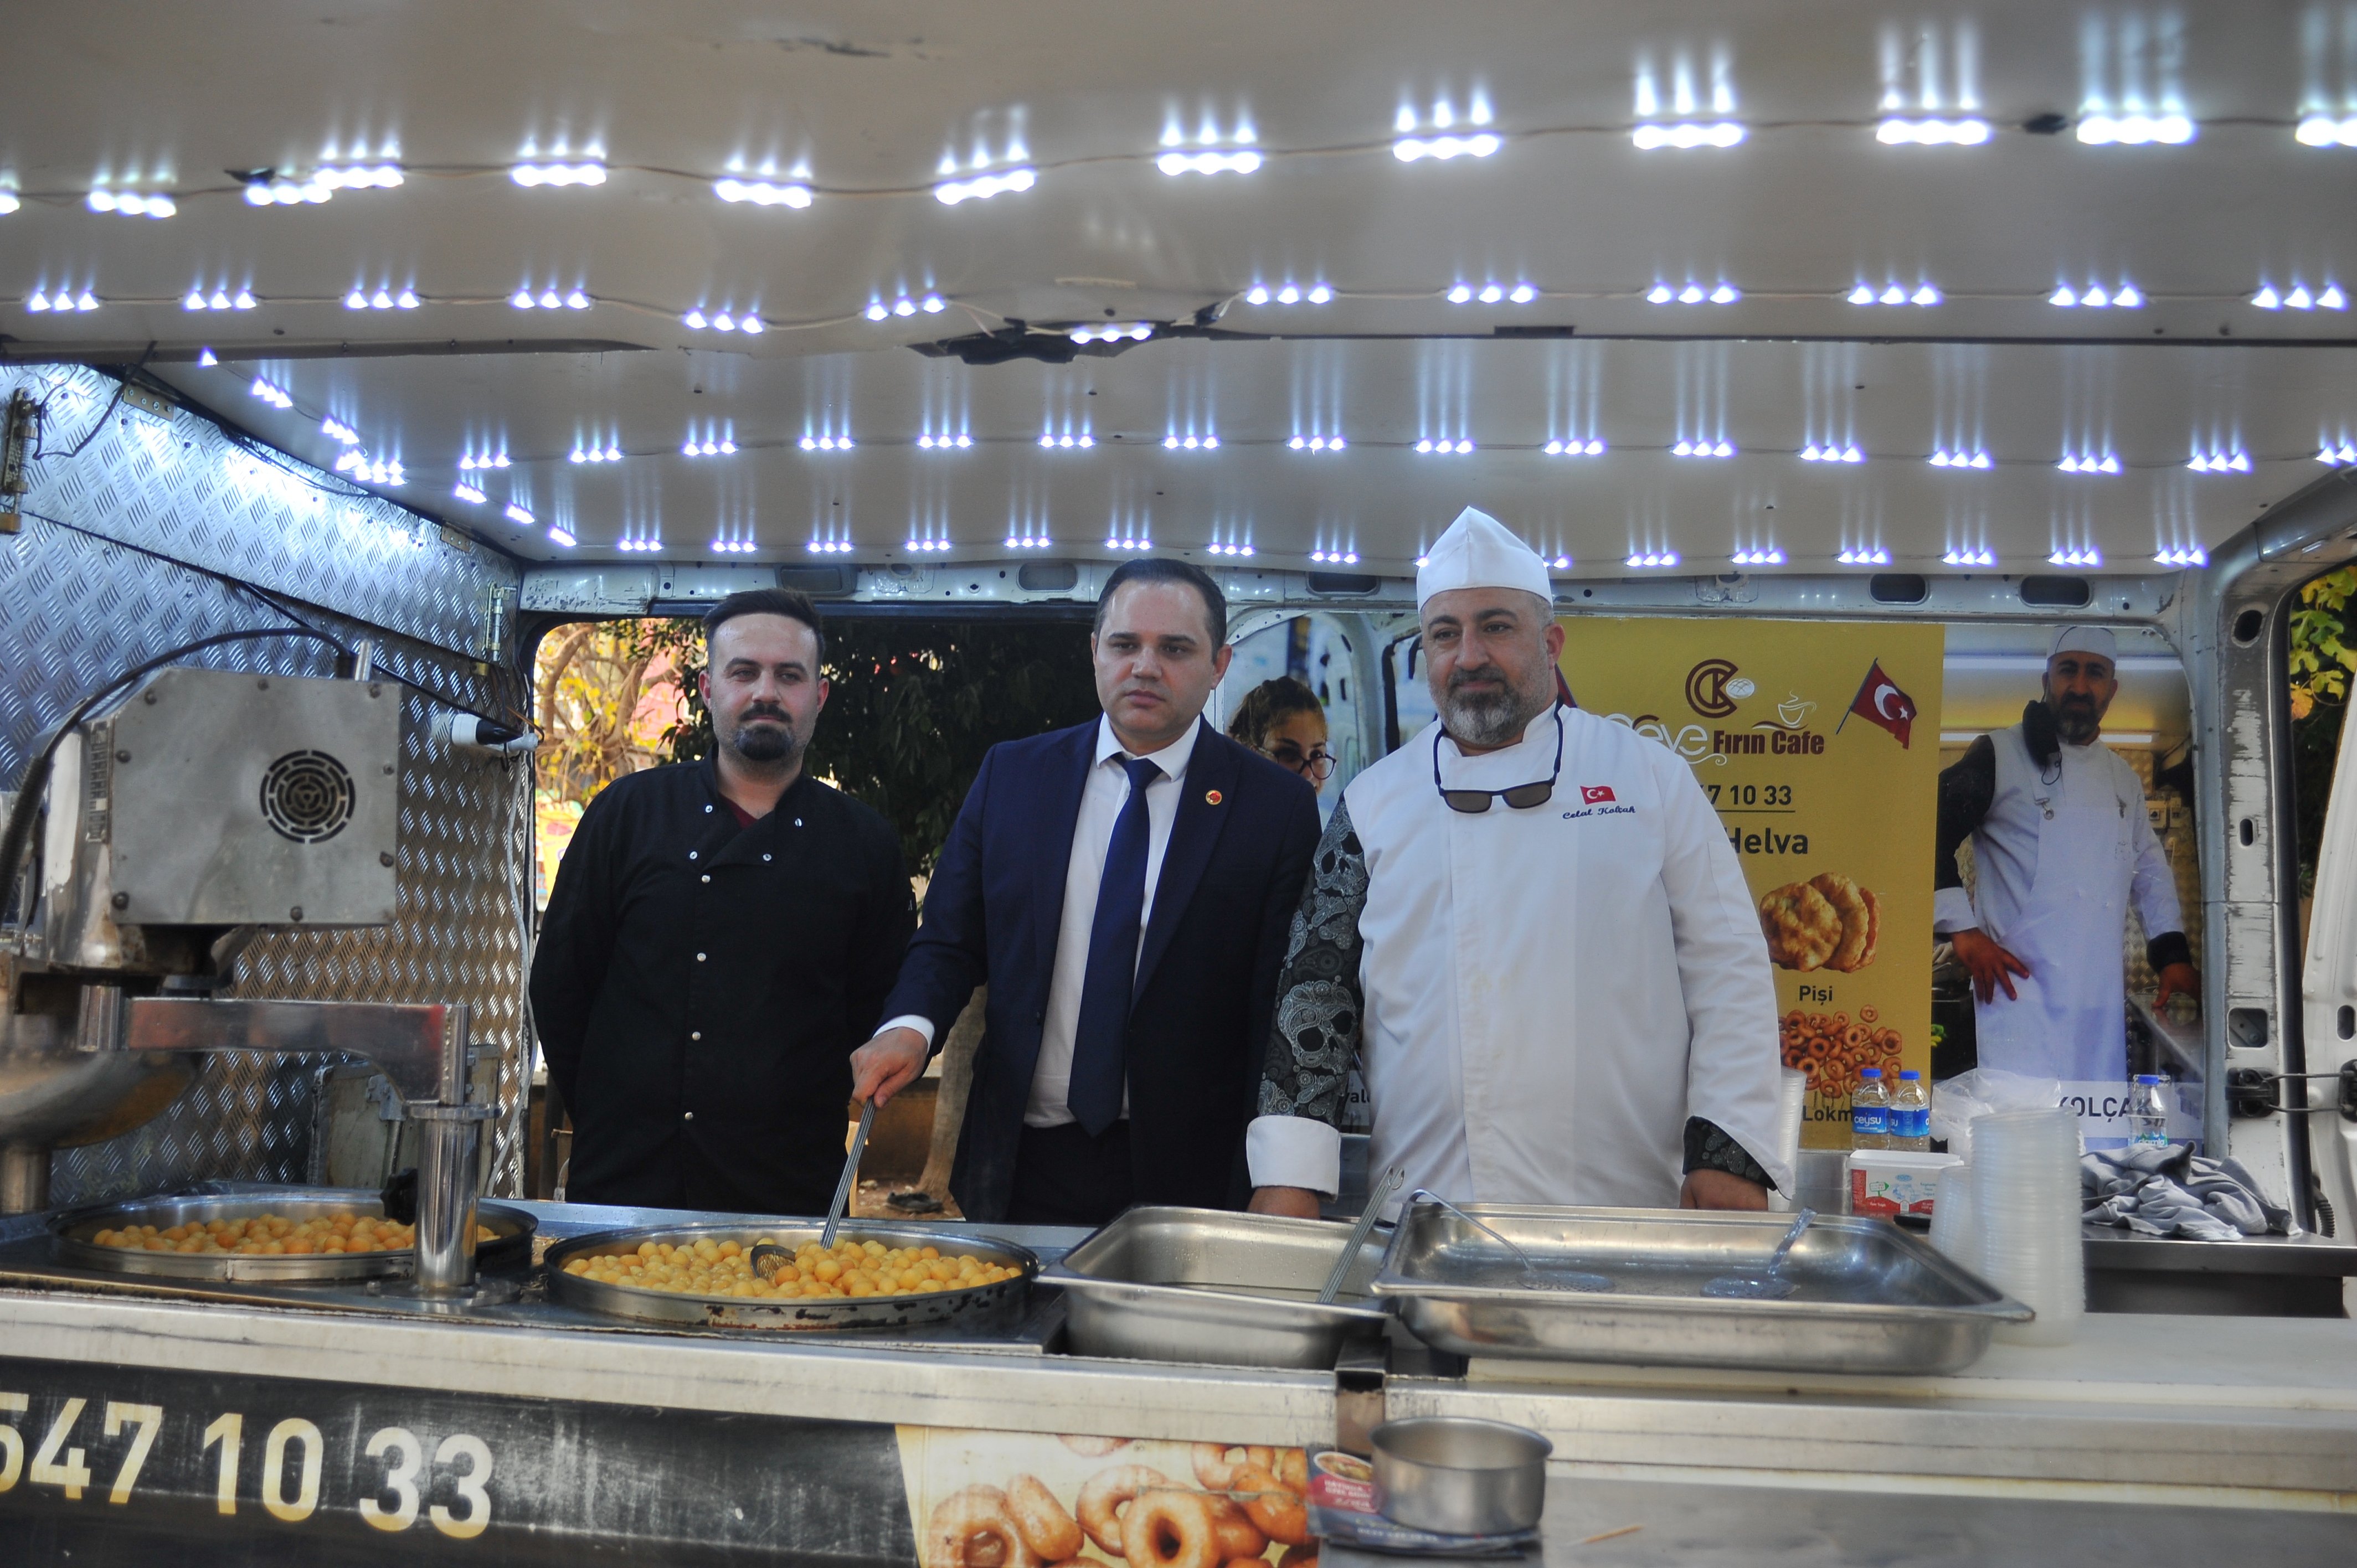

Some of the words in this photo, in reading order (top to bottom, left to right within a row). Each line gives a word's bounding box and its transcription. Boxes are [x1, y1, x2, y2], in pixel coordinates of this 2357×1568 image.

[1713, 730, 1765, 755] Fırın
[1772, 730, 1824, 755] Cafe
[1730, 785, 1756, 805] 10
[1764, 785, 1792, 806] 33
[1562, 808, 1593, 819] Celal
[1597, 805, 1636, 816] Kolçak
[1724, 827, 1809, 854] Helva
[1799, 985, 1833, 1005] Pişi
[1803, 1105, 1852, 1122] Lokm
[1854, 1116, 1882, 1127] ceysu
[202, 1411, 325, 1522] 10
[358, 1426, 493, 1539] 33
